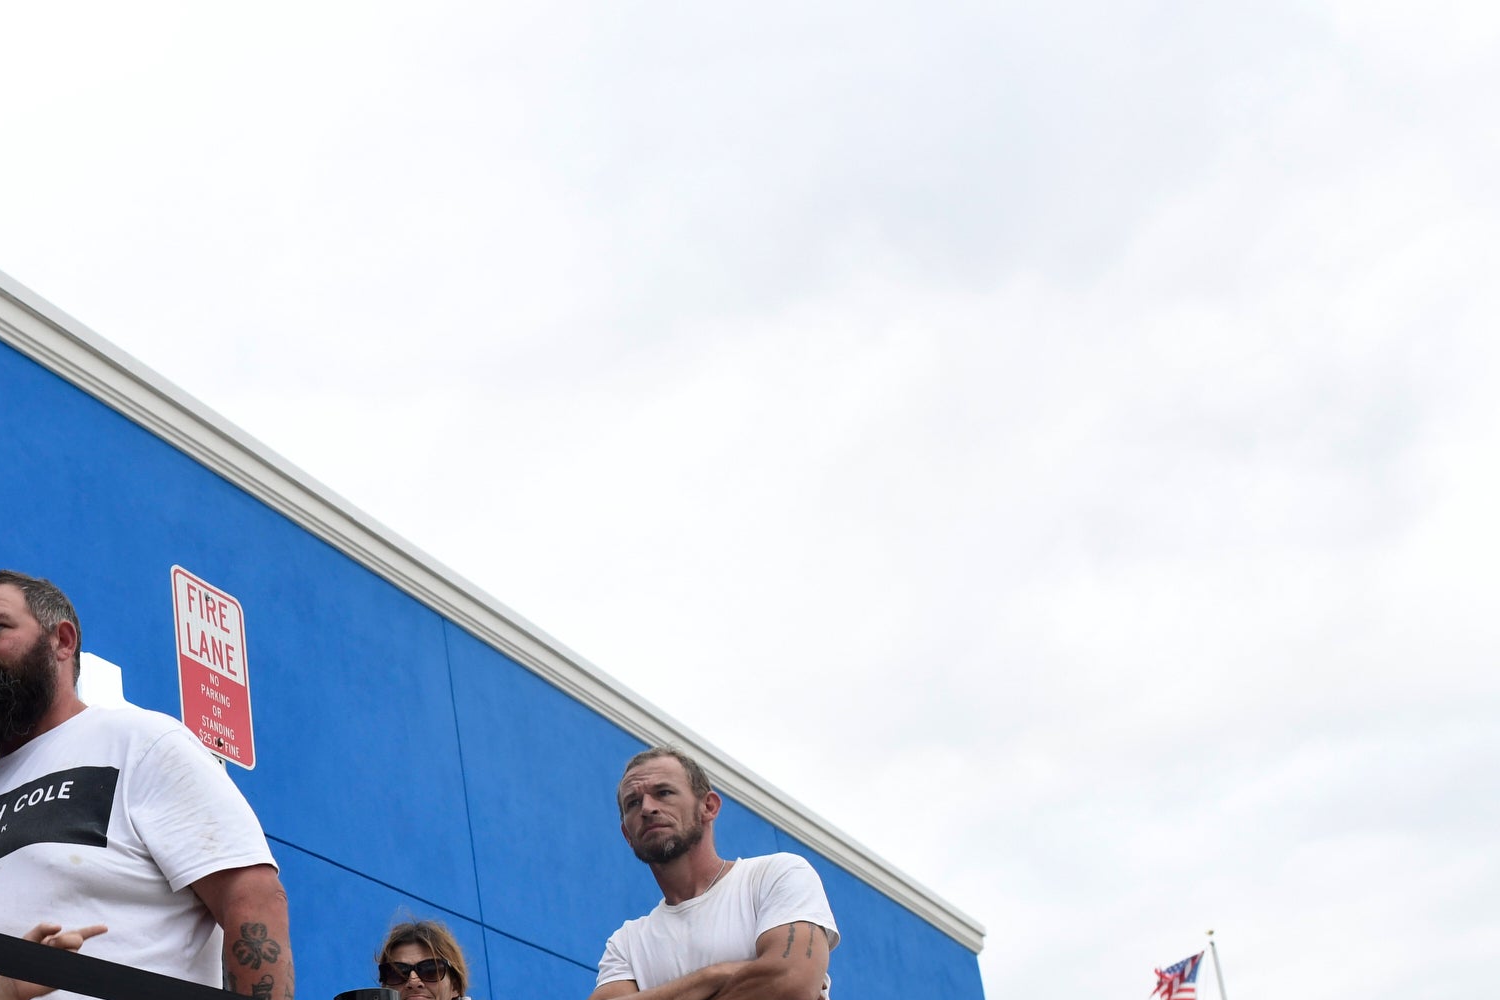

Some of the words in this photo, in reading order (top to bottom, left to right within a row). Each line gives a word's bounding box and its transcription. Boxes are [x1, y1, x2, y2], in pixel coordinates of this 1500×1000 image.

[186, 582, 230, 634] FIRE
[186, 622, 237, 676] LANE
[209, 672, 220, 687] NO
[200, 683, 231, 708] PARKING
[212, 704, 222, 719] OR
[201, 715, 235, 741] STANDING
[198, 729, 224, 750] $25.0
[224, 741, 241, 759] FINE
[13, 780, 74, 813] COLE
